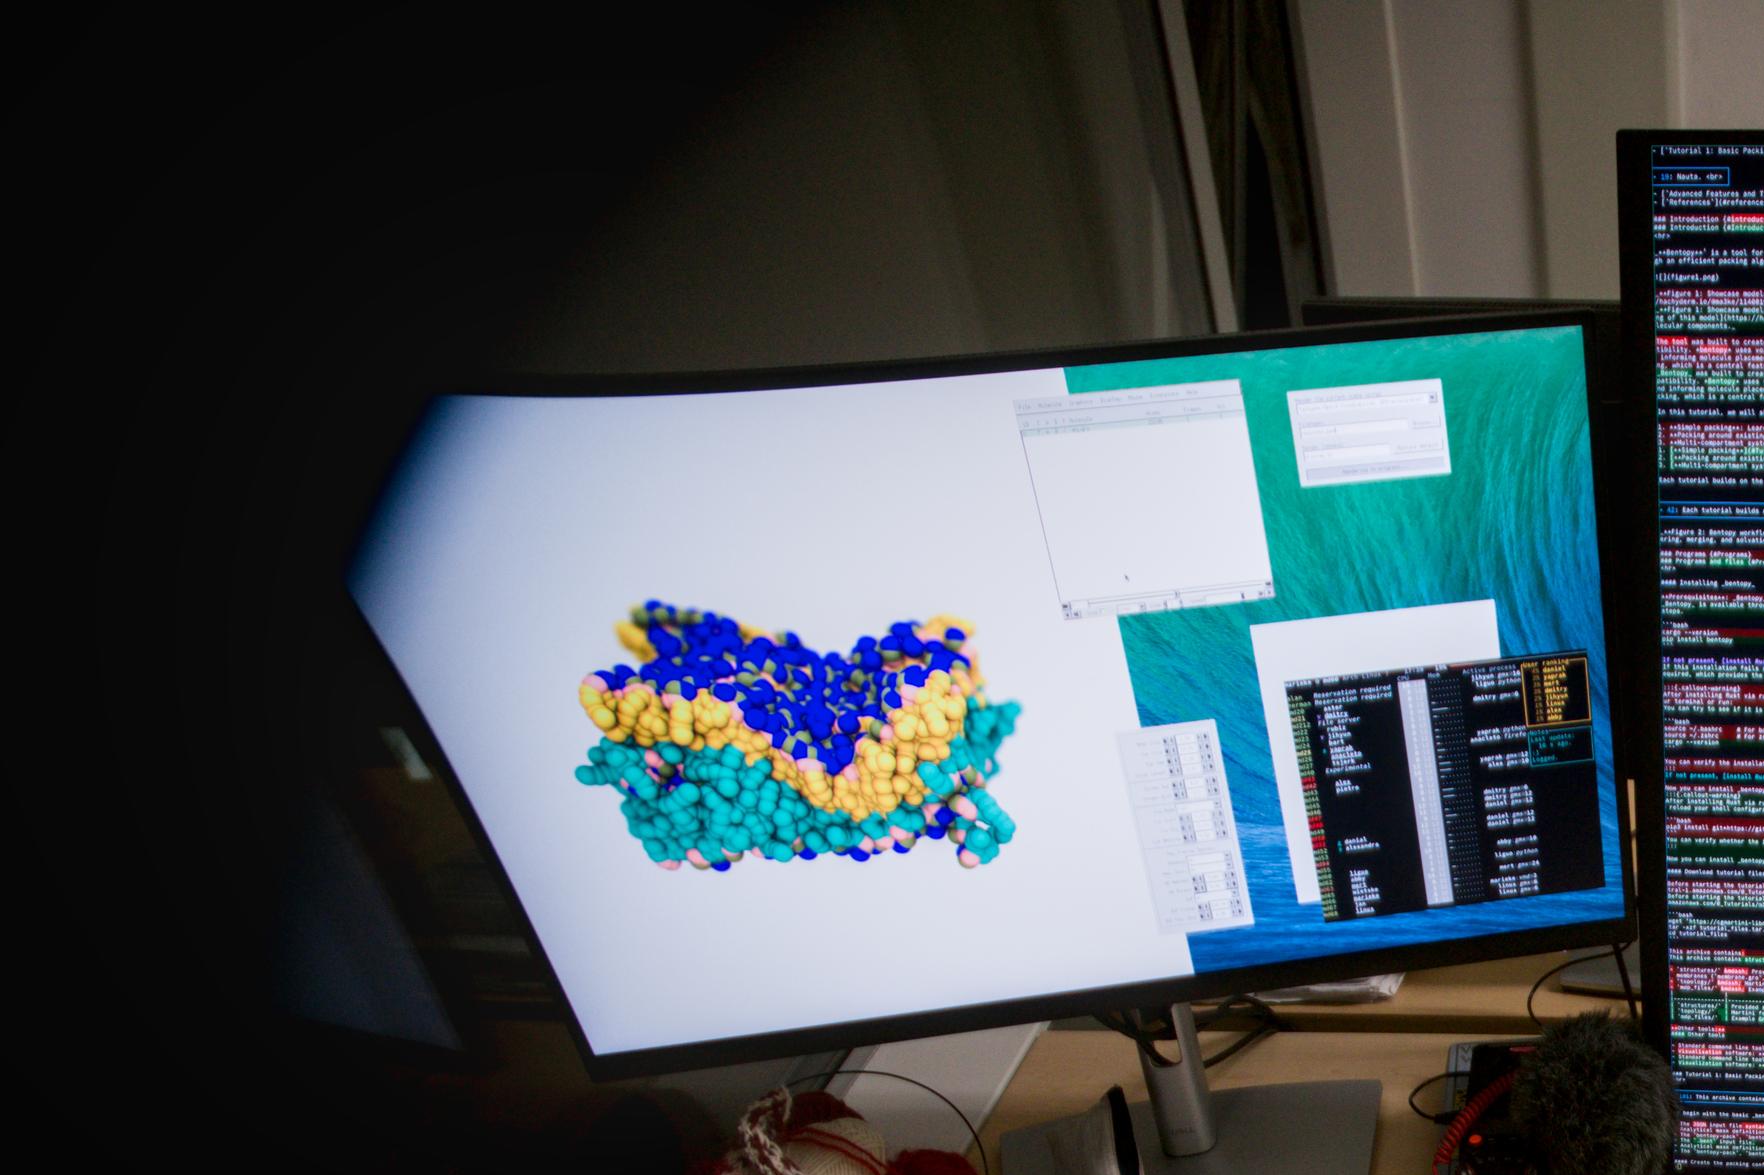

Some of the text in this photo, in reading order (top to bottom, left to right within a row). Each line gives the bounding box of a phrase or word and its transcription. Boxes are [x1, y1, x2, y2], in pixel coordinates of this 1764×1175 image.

[1706, 147, 1714, 155] 1:
[1718, 146, 1738, 155] Basic
[1676, 172, 1702, 181] Nauta.
[1706, 190, 1739, 198] Features
[1743, 190, 1756, 198] and
[1670, 215, 1720, 224] Introduction
[1670, 224, 1720, 232] Introduction
[1654, 232, 1670, 240] <hr>
[1658, 408, 1666, 416] In
[1669, 408, 1686, 416] this
[1689, 408, 1724, 417] tutorial,
[1542, 658, 1570, 667] ranking
[1462, 664, 1516, 675] Active process
[1313, 684, 1392, 700] Reservation required
[1314, 692, 1392, 705] Reservation required
[1336, 716, 1360, 724] server
[1325, 763, 1372, 774] Experimental
